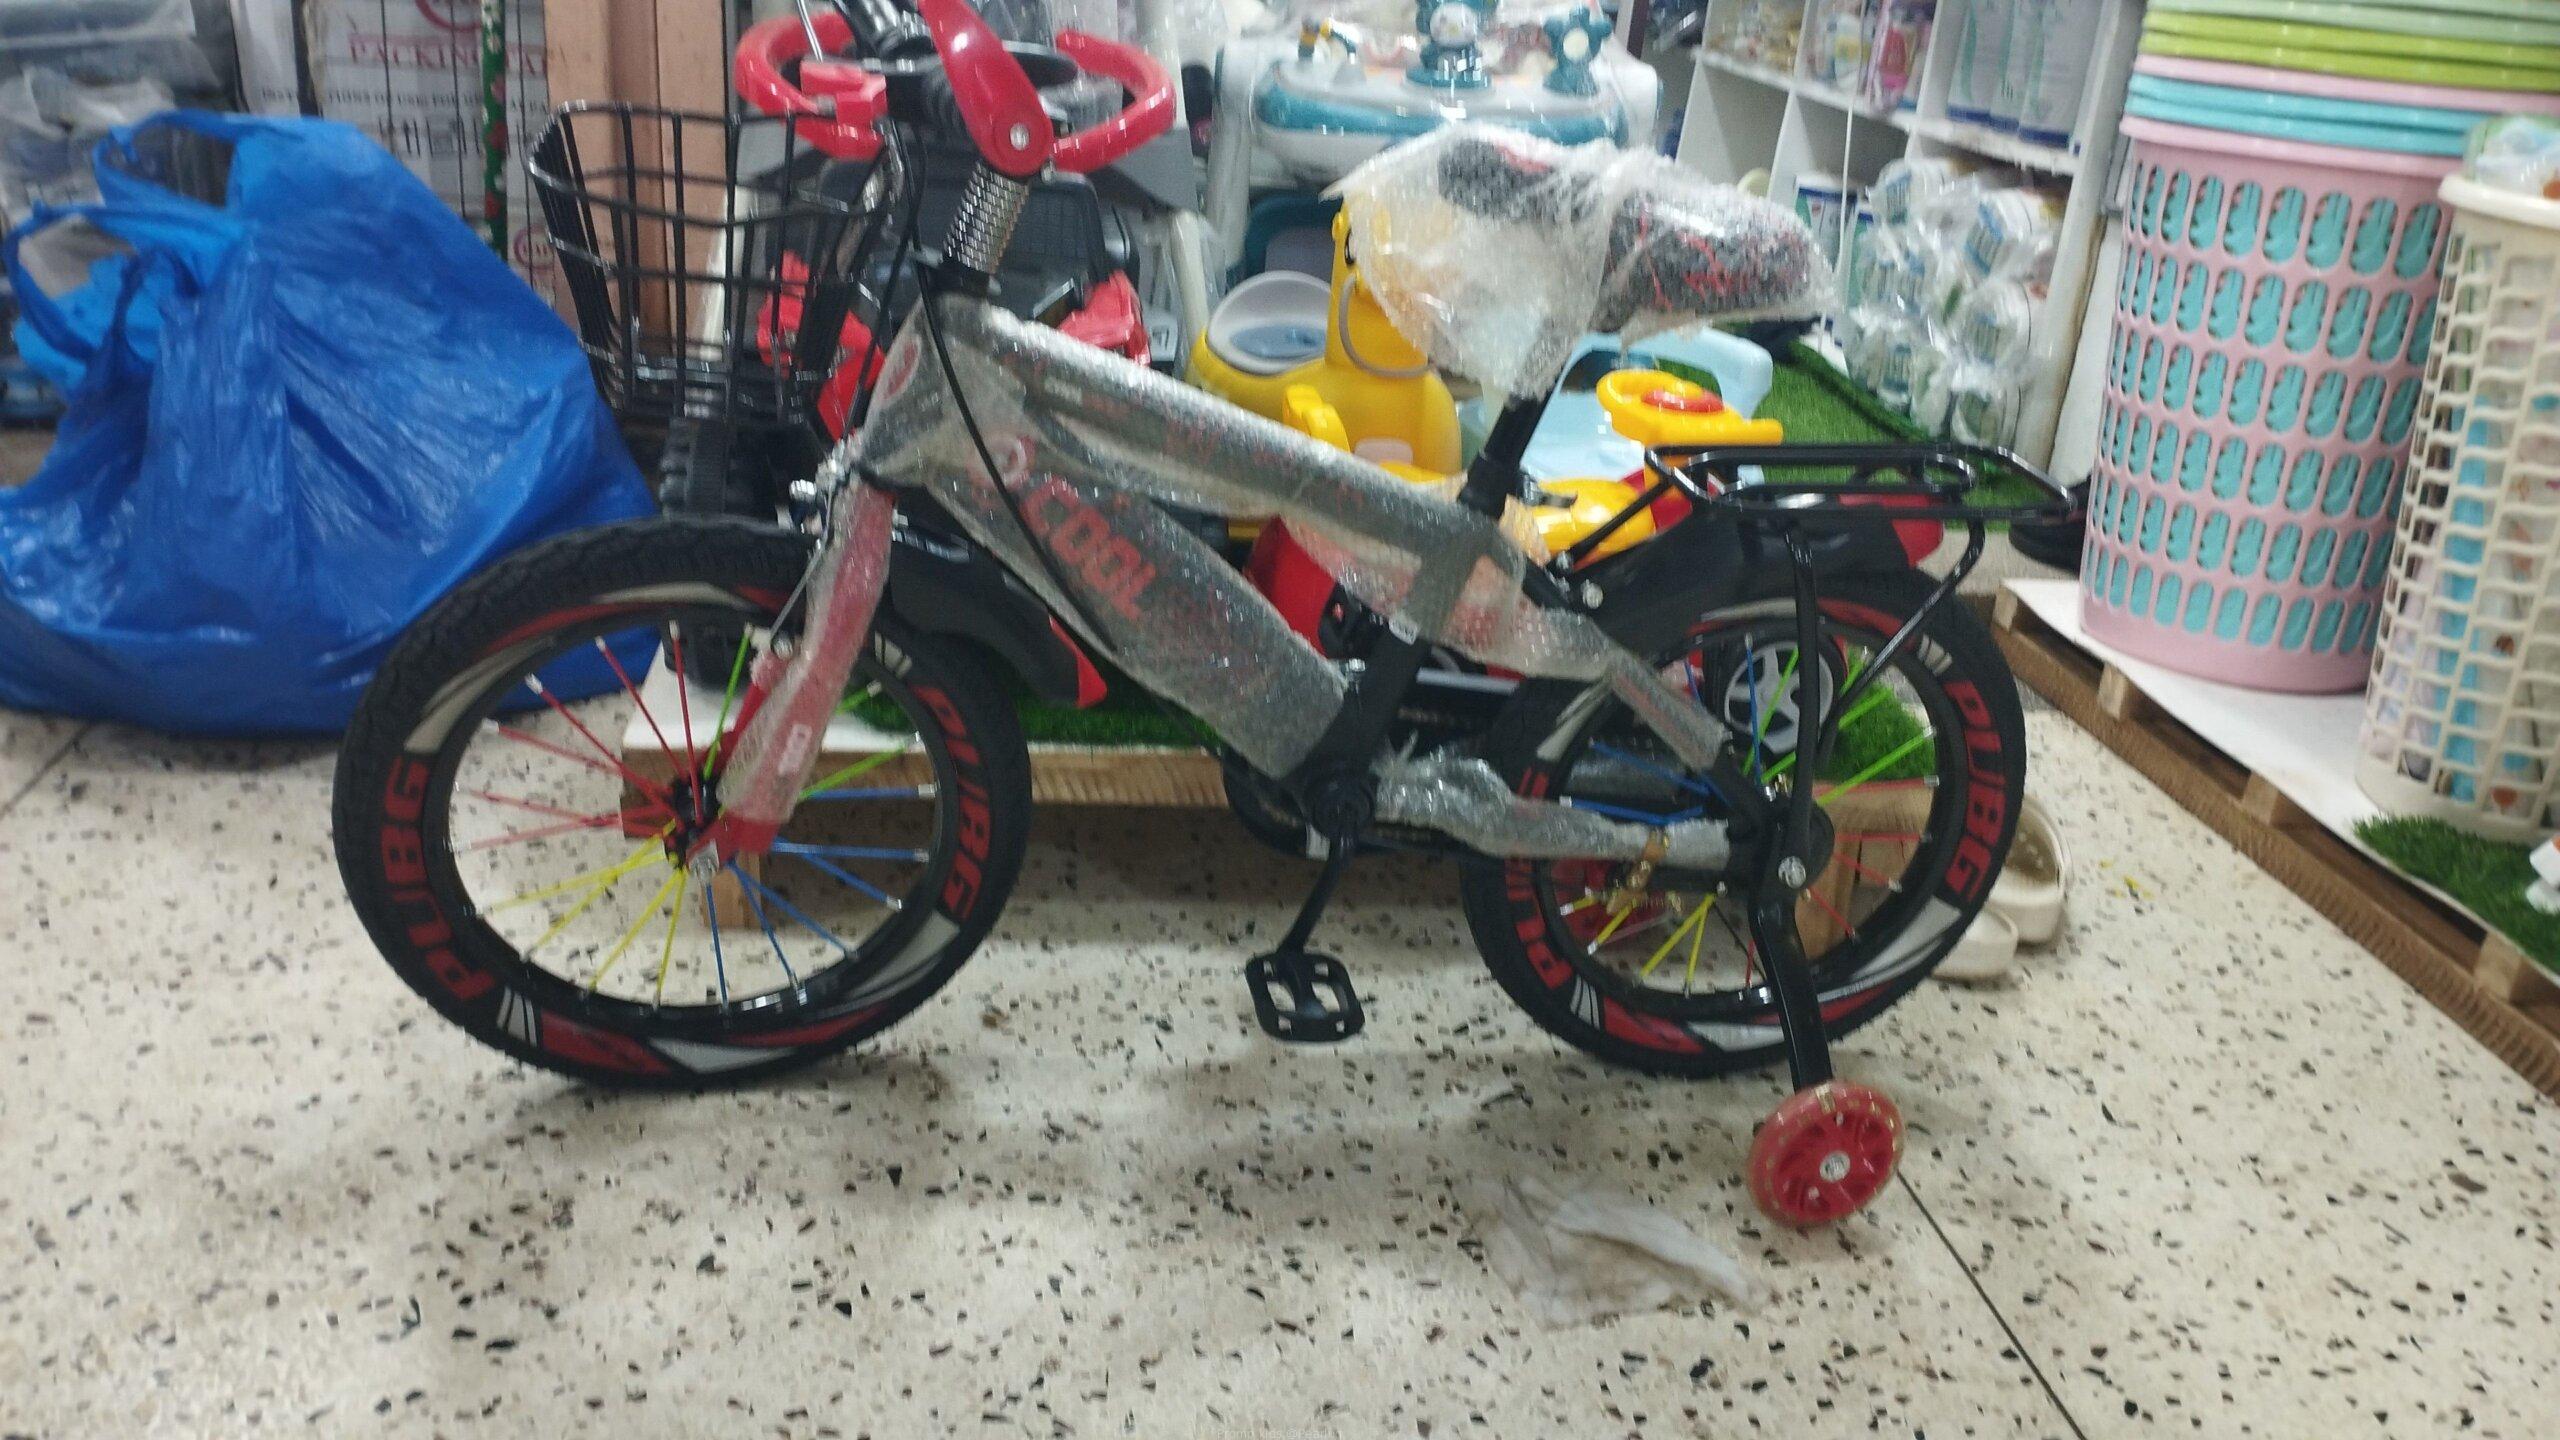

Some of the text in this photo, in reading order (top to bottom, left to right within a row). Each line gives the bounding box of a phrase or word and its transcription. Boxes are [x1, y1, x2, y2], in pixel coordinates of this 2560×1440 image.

[1019, 474, 1156, 620] COOL
[381, 758, 496, 1001] PUBG
[909, 683, 991, 922] PUBG
[1943, 679, 2006, 902] PUBG
